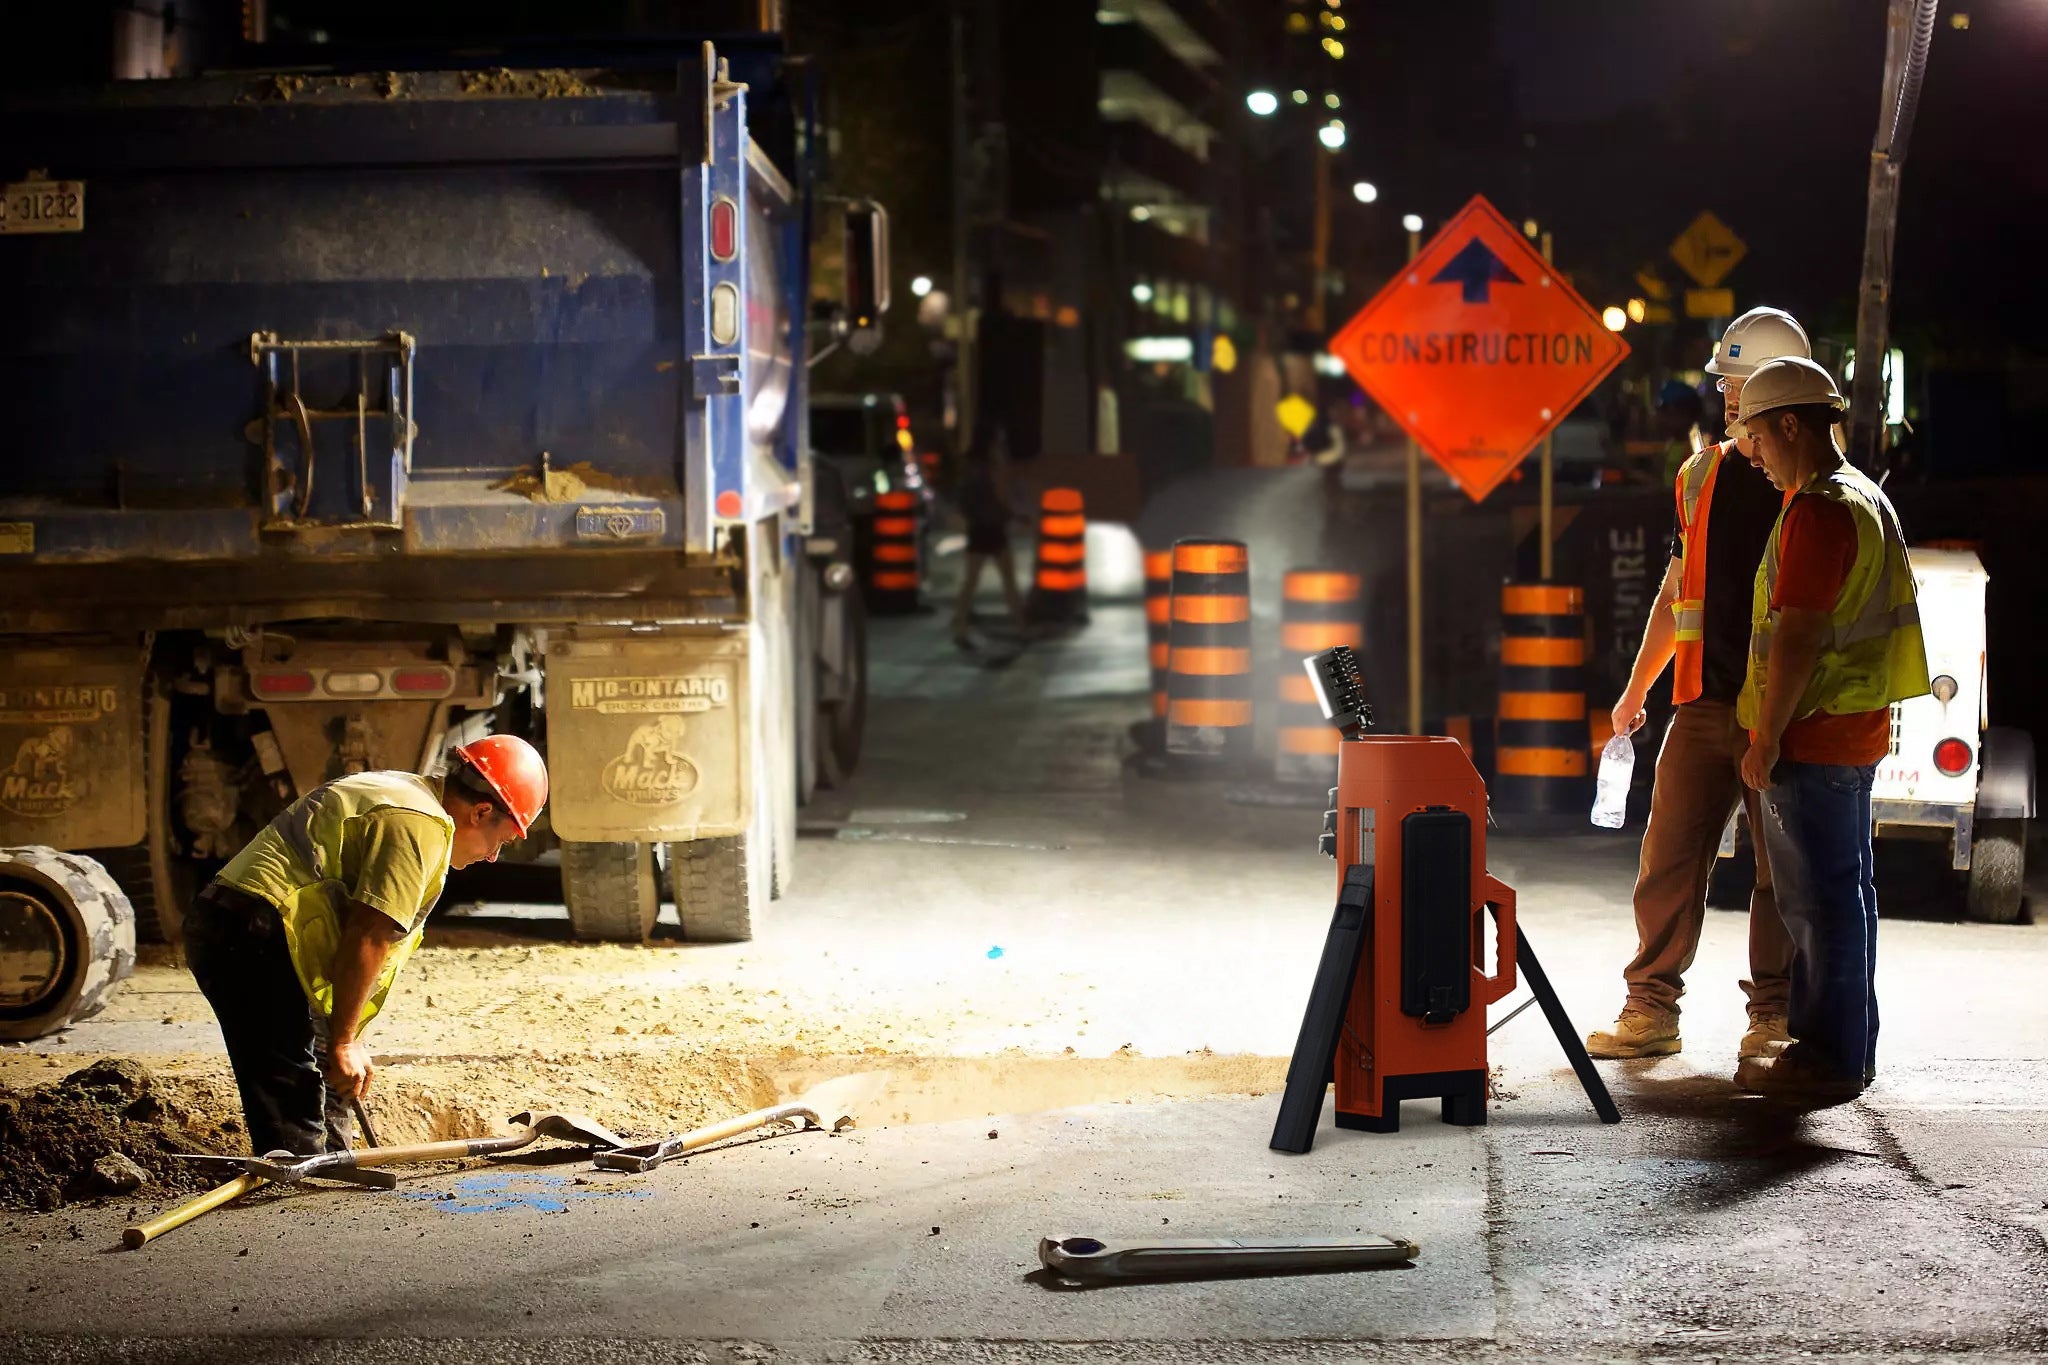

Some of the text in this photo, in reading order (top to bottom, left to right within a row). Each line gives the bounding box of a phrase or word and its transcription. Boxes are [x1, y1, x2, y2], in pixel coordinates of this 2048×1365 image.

[1361, 332, 1593, 364] CONSTRUCTION
[572, 679, 727, 707] MID-ONTARIO
[605, 702, 648, 711] TRUCK
[2, 776, 76, 799] Mack
[614, 764, 686, 789] Mack
